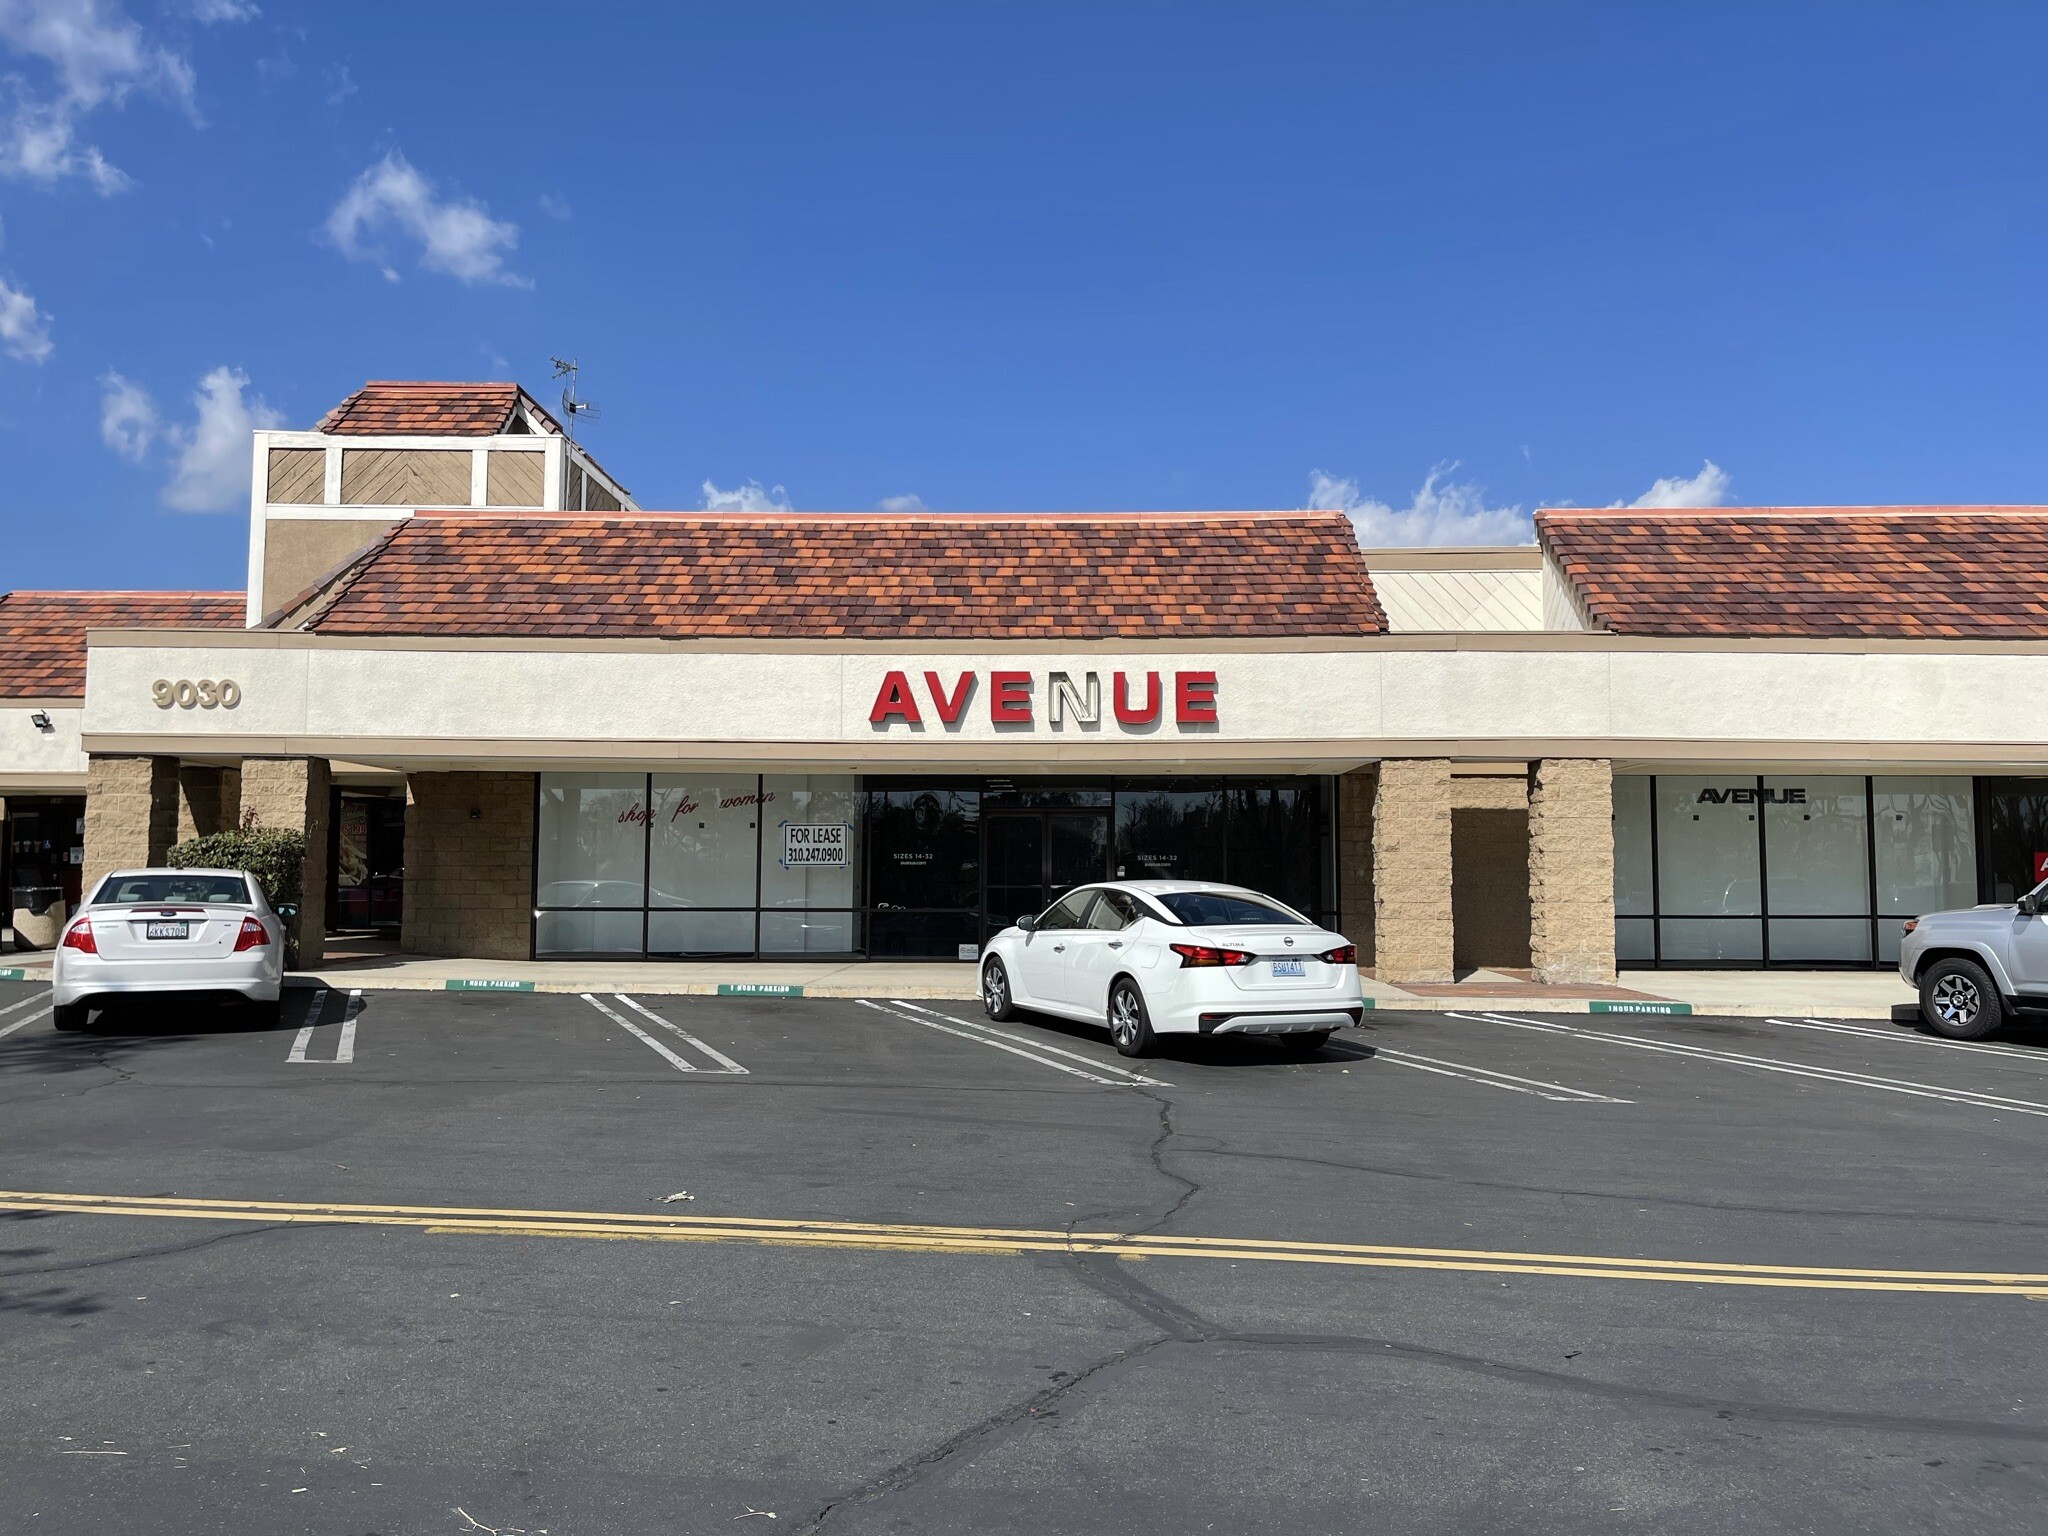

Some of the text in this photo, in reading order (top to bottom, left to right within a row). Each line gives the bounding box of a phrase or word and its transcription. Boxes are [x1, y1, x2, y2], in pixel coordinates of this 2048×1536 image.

[152, 679, 241, 707] 9030
[869, 671, 1217, 726] AVENUE
[1696, 788, 1806, 804] AVENUE
[618, 791, 776, 827] shop for women
[790, 828, 841, 843] FOR LEASE
[788, 848, 843, 862] 310.247.0900
[490, 980, 520, 988] PARKING
[737, 984, 756, 992] HOUR
